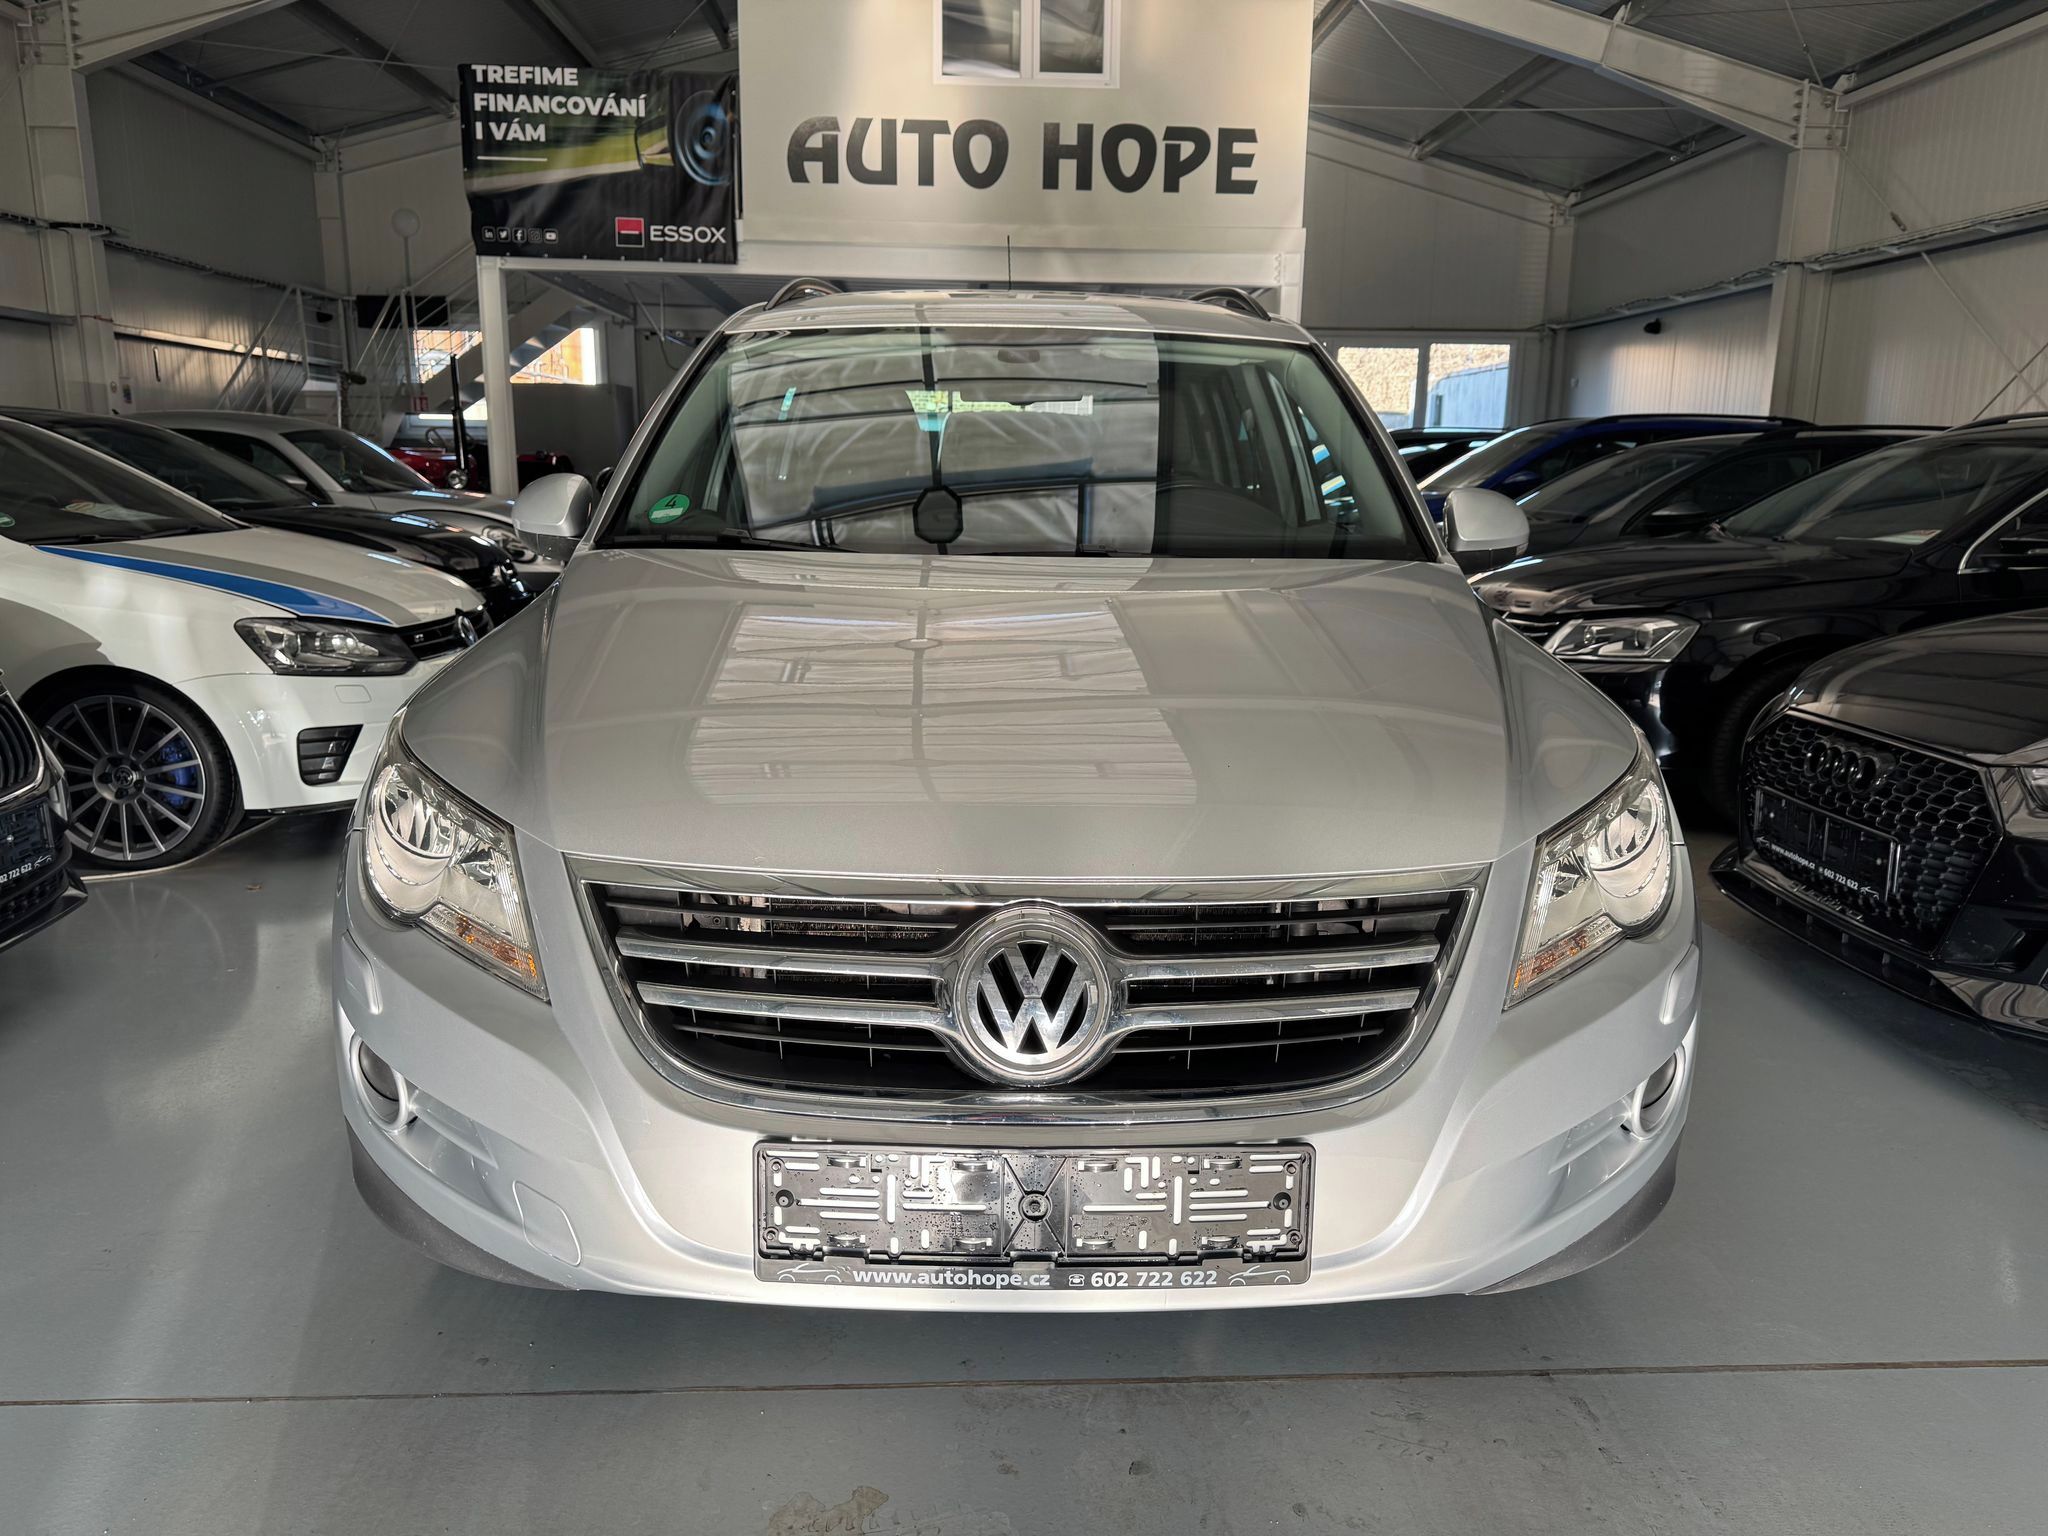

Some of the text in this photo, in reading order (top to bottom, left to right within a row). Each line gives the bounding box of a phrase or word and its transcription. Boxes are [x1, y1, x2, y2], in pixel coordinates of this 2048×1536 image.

[471, 64, 579, 86] TREFIME
[473, 92, 648, 117] FINANCOVÁNÍ
[475, 117, 547, 142] I VÁM
[787, 116, 1258, 194] AUTO HOPE
[650, 225, 726, 243] ESSOX
[664, 495, 678, 509] 4
[852, 1269, 1218, 1289] www.autohope.cz 602 722 622
